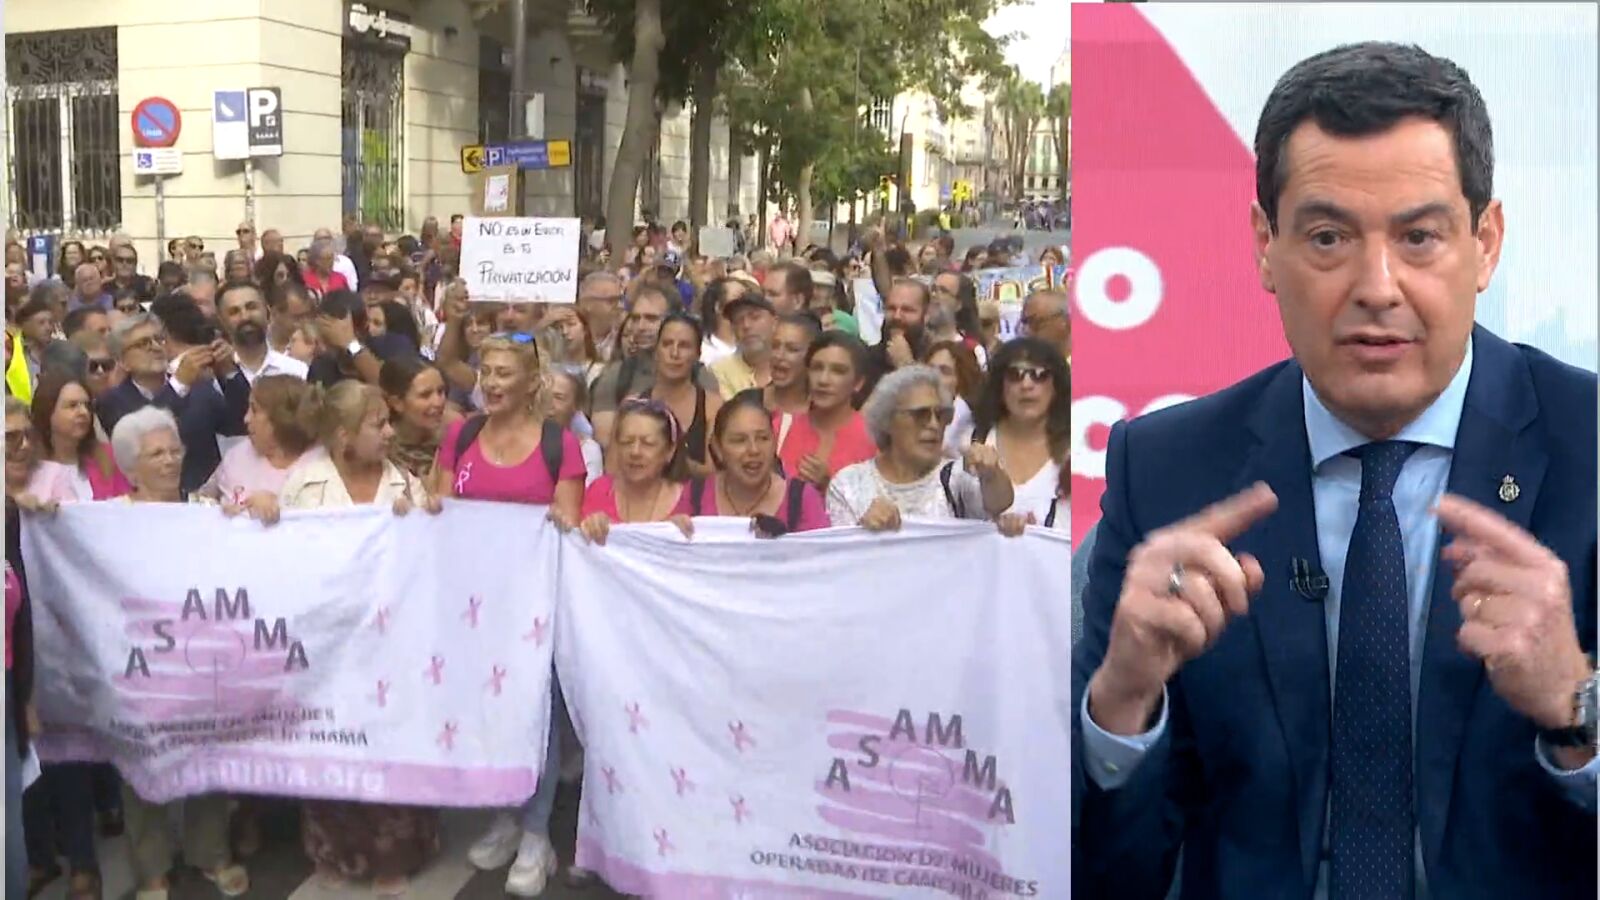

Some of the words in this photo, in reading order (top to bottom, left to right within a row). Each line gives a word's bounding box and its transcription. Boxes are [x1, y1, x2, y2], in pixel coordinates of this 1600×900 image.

[250, 89, 278, 127] P
[489, 150, 501, 167] P
[480, 222, 502, 237] NO
[124, 586, 310, 679] ASAMMA
[824, 708, 1016, 825] ASAMMA
[950, 854, 1040, 897] MUJERES
